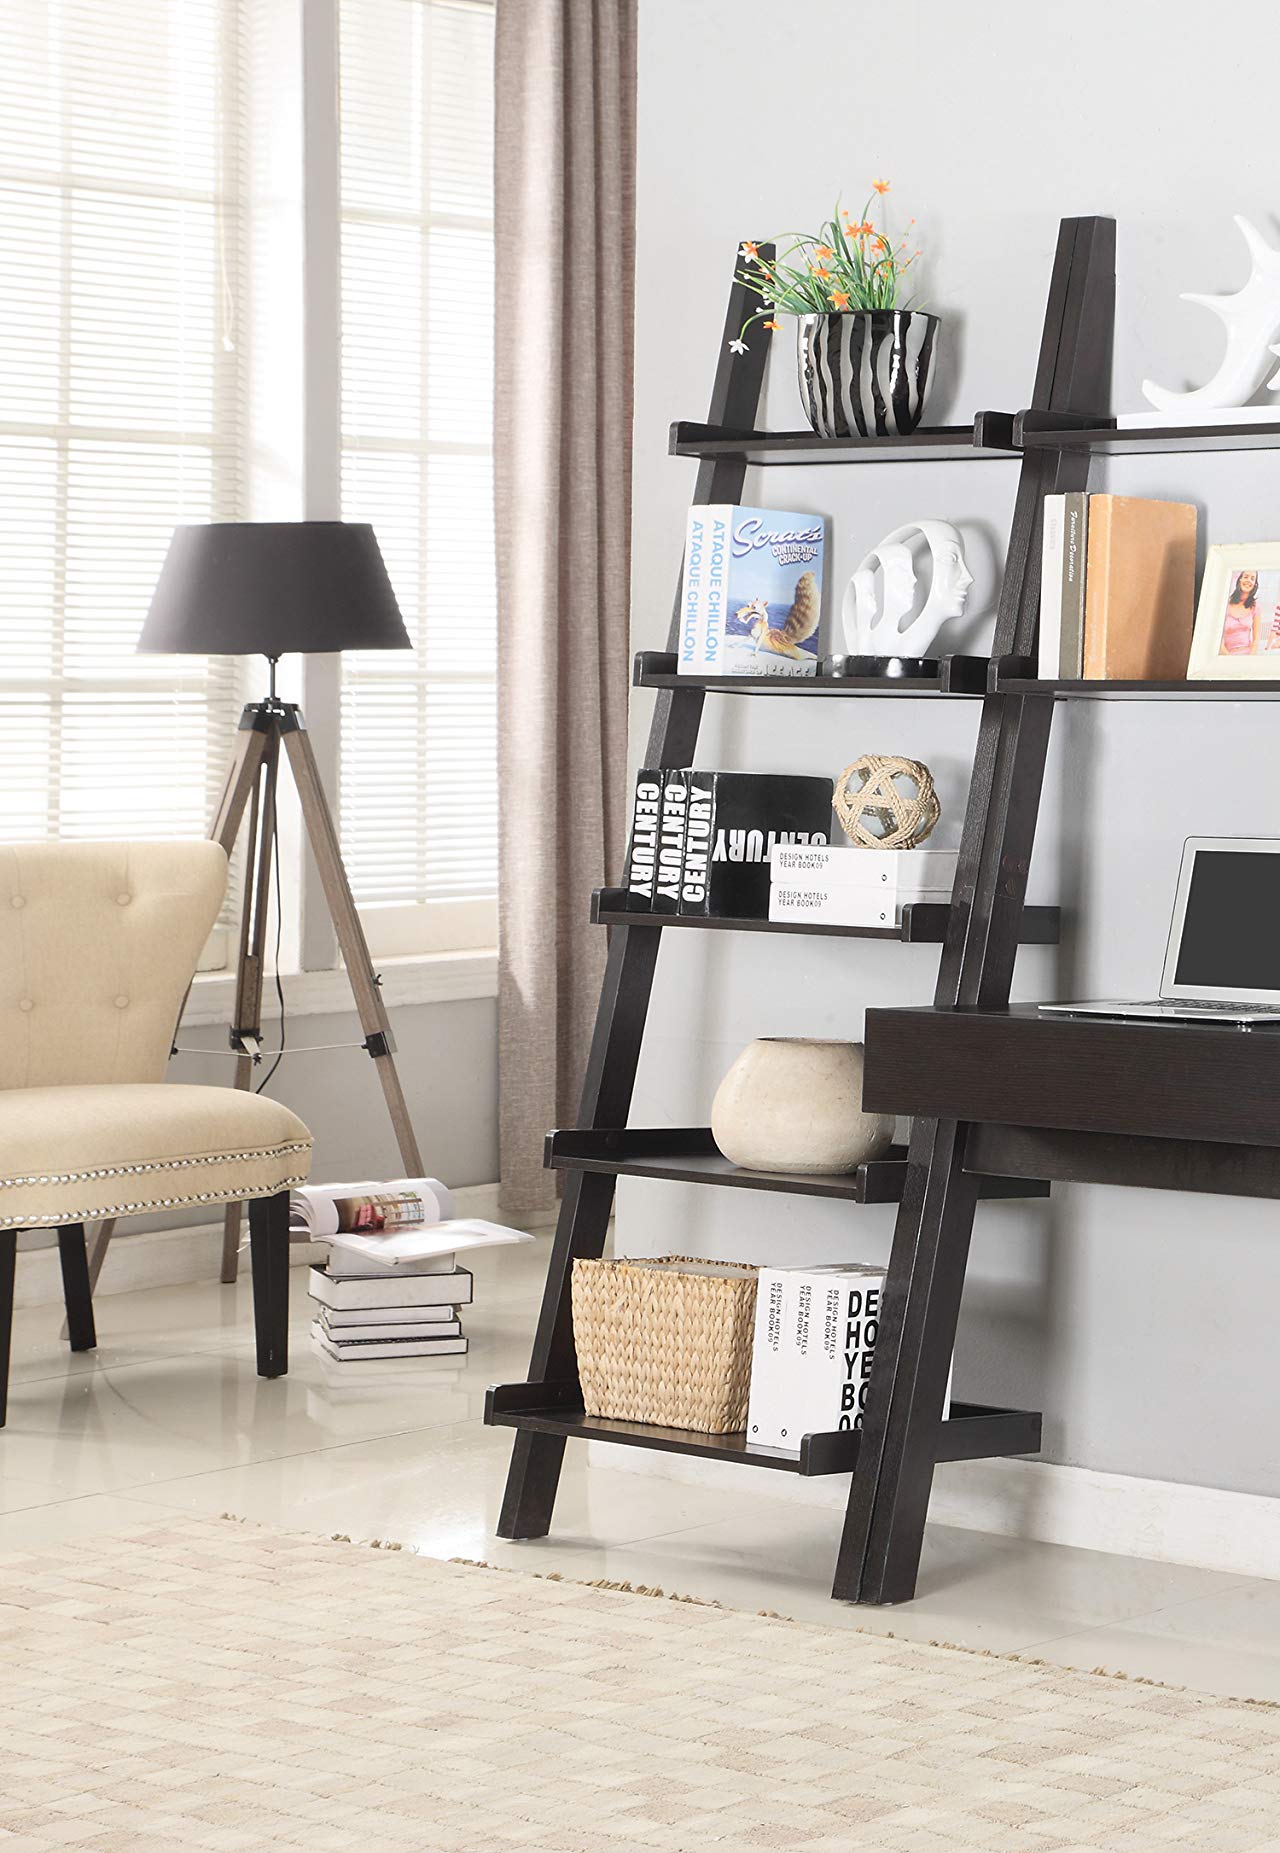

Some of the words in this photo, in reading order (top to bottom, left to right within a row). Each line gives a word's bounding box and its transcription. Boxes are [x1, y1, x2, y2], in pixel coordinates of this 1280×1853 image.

[688, 521, 704, 587] ATAQUE
[709, 520, 725, 587] ATAQUE
[682, 593, 699, 662] CHILLON
[704, 593, 721, 662] CHILLON
[629, 782, 660, 898] CENTURY
[657, 784, 688, 900] CENTURY
[682, 786, 712, 902] CENTURY
[780, 852, 803, 861] DESIGN
[804, 854, 829, 862] HOTELS
[780, 860, 796, 868] YEAR
[778, 890, 801, 899] DESIGN
[803, 892, 828, 901] HOTELS
[778, 898, 795, 906] YEAR
[775, 1282, 783, 1315] DESIGN
[804, 1285, 812, 1318] DESIGN
[773, 1318, 781, 1352] HOTELS
[801, 1321, 809, 1355] HOTELS
[829, 1325, 837, 1360] HOTELS
